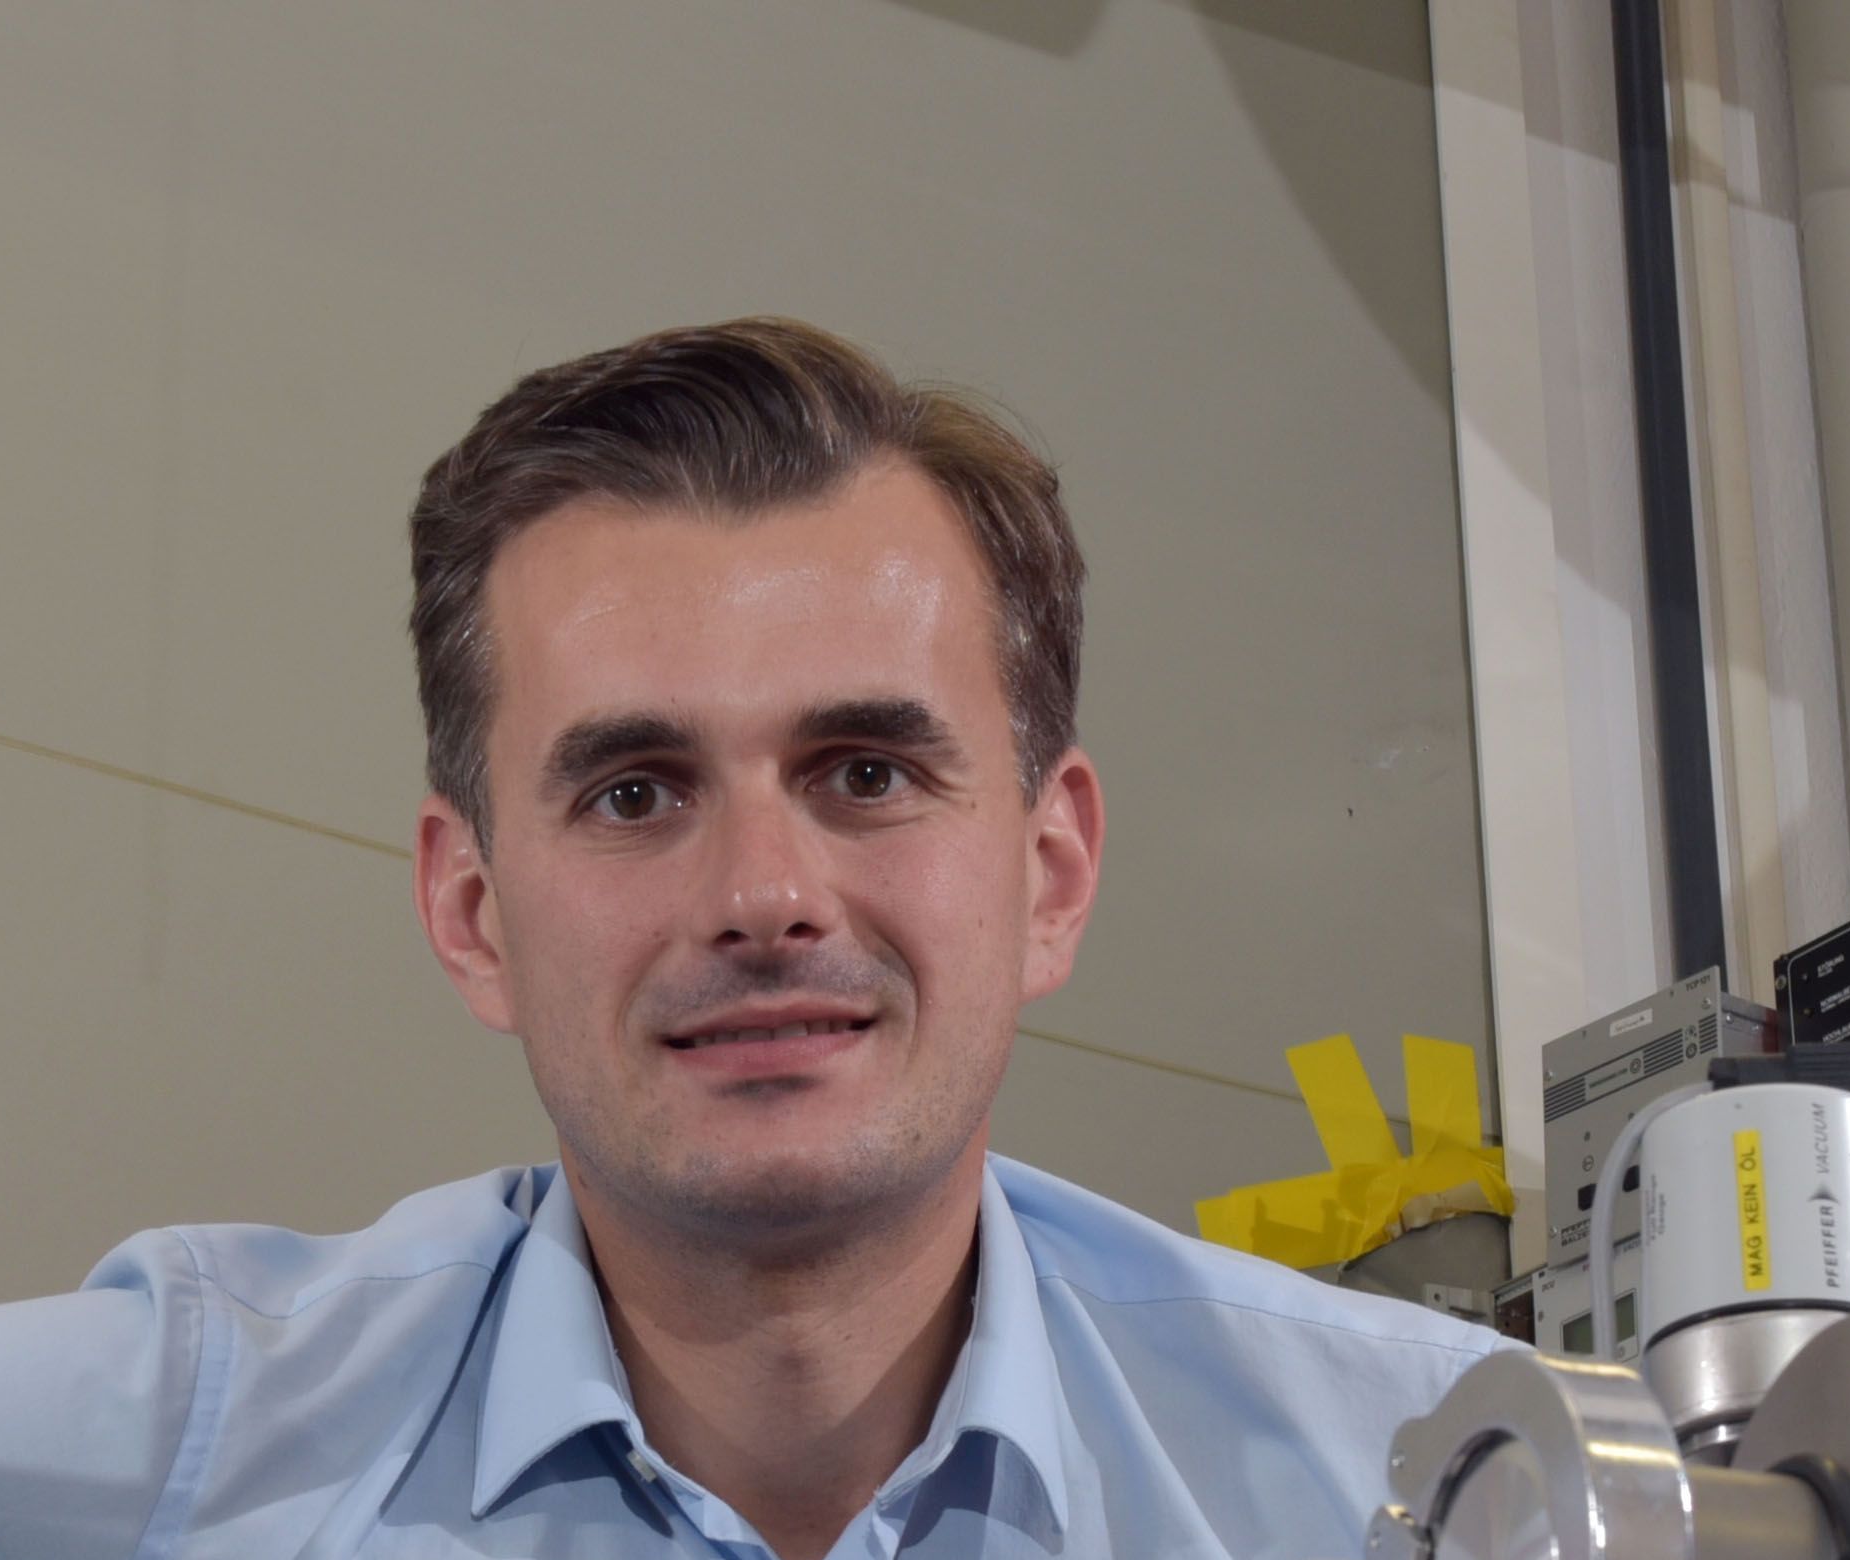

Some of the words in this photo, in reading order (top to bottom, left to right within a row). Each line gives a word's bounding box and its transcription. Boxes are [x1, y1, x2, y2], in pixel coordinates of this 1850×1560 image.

[1739, 1147, 1757, 1172] ÖL
[1811, 1103, 1830, 1175] VACUUM
[1744, 1183, 1760, 1224] KEIN
[1747, 1234, 1764, 1277] MAG
[1819, 1205, 1841, 1288] PFEIFFER
